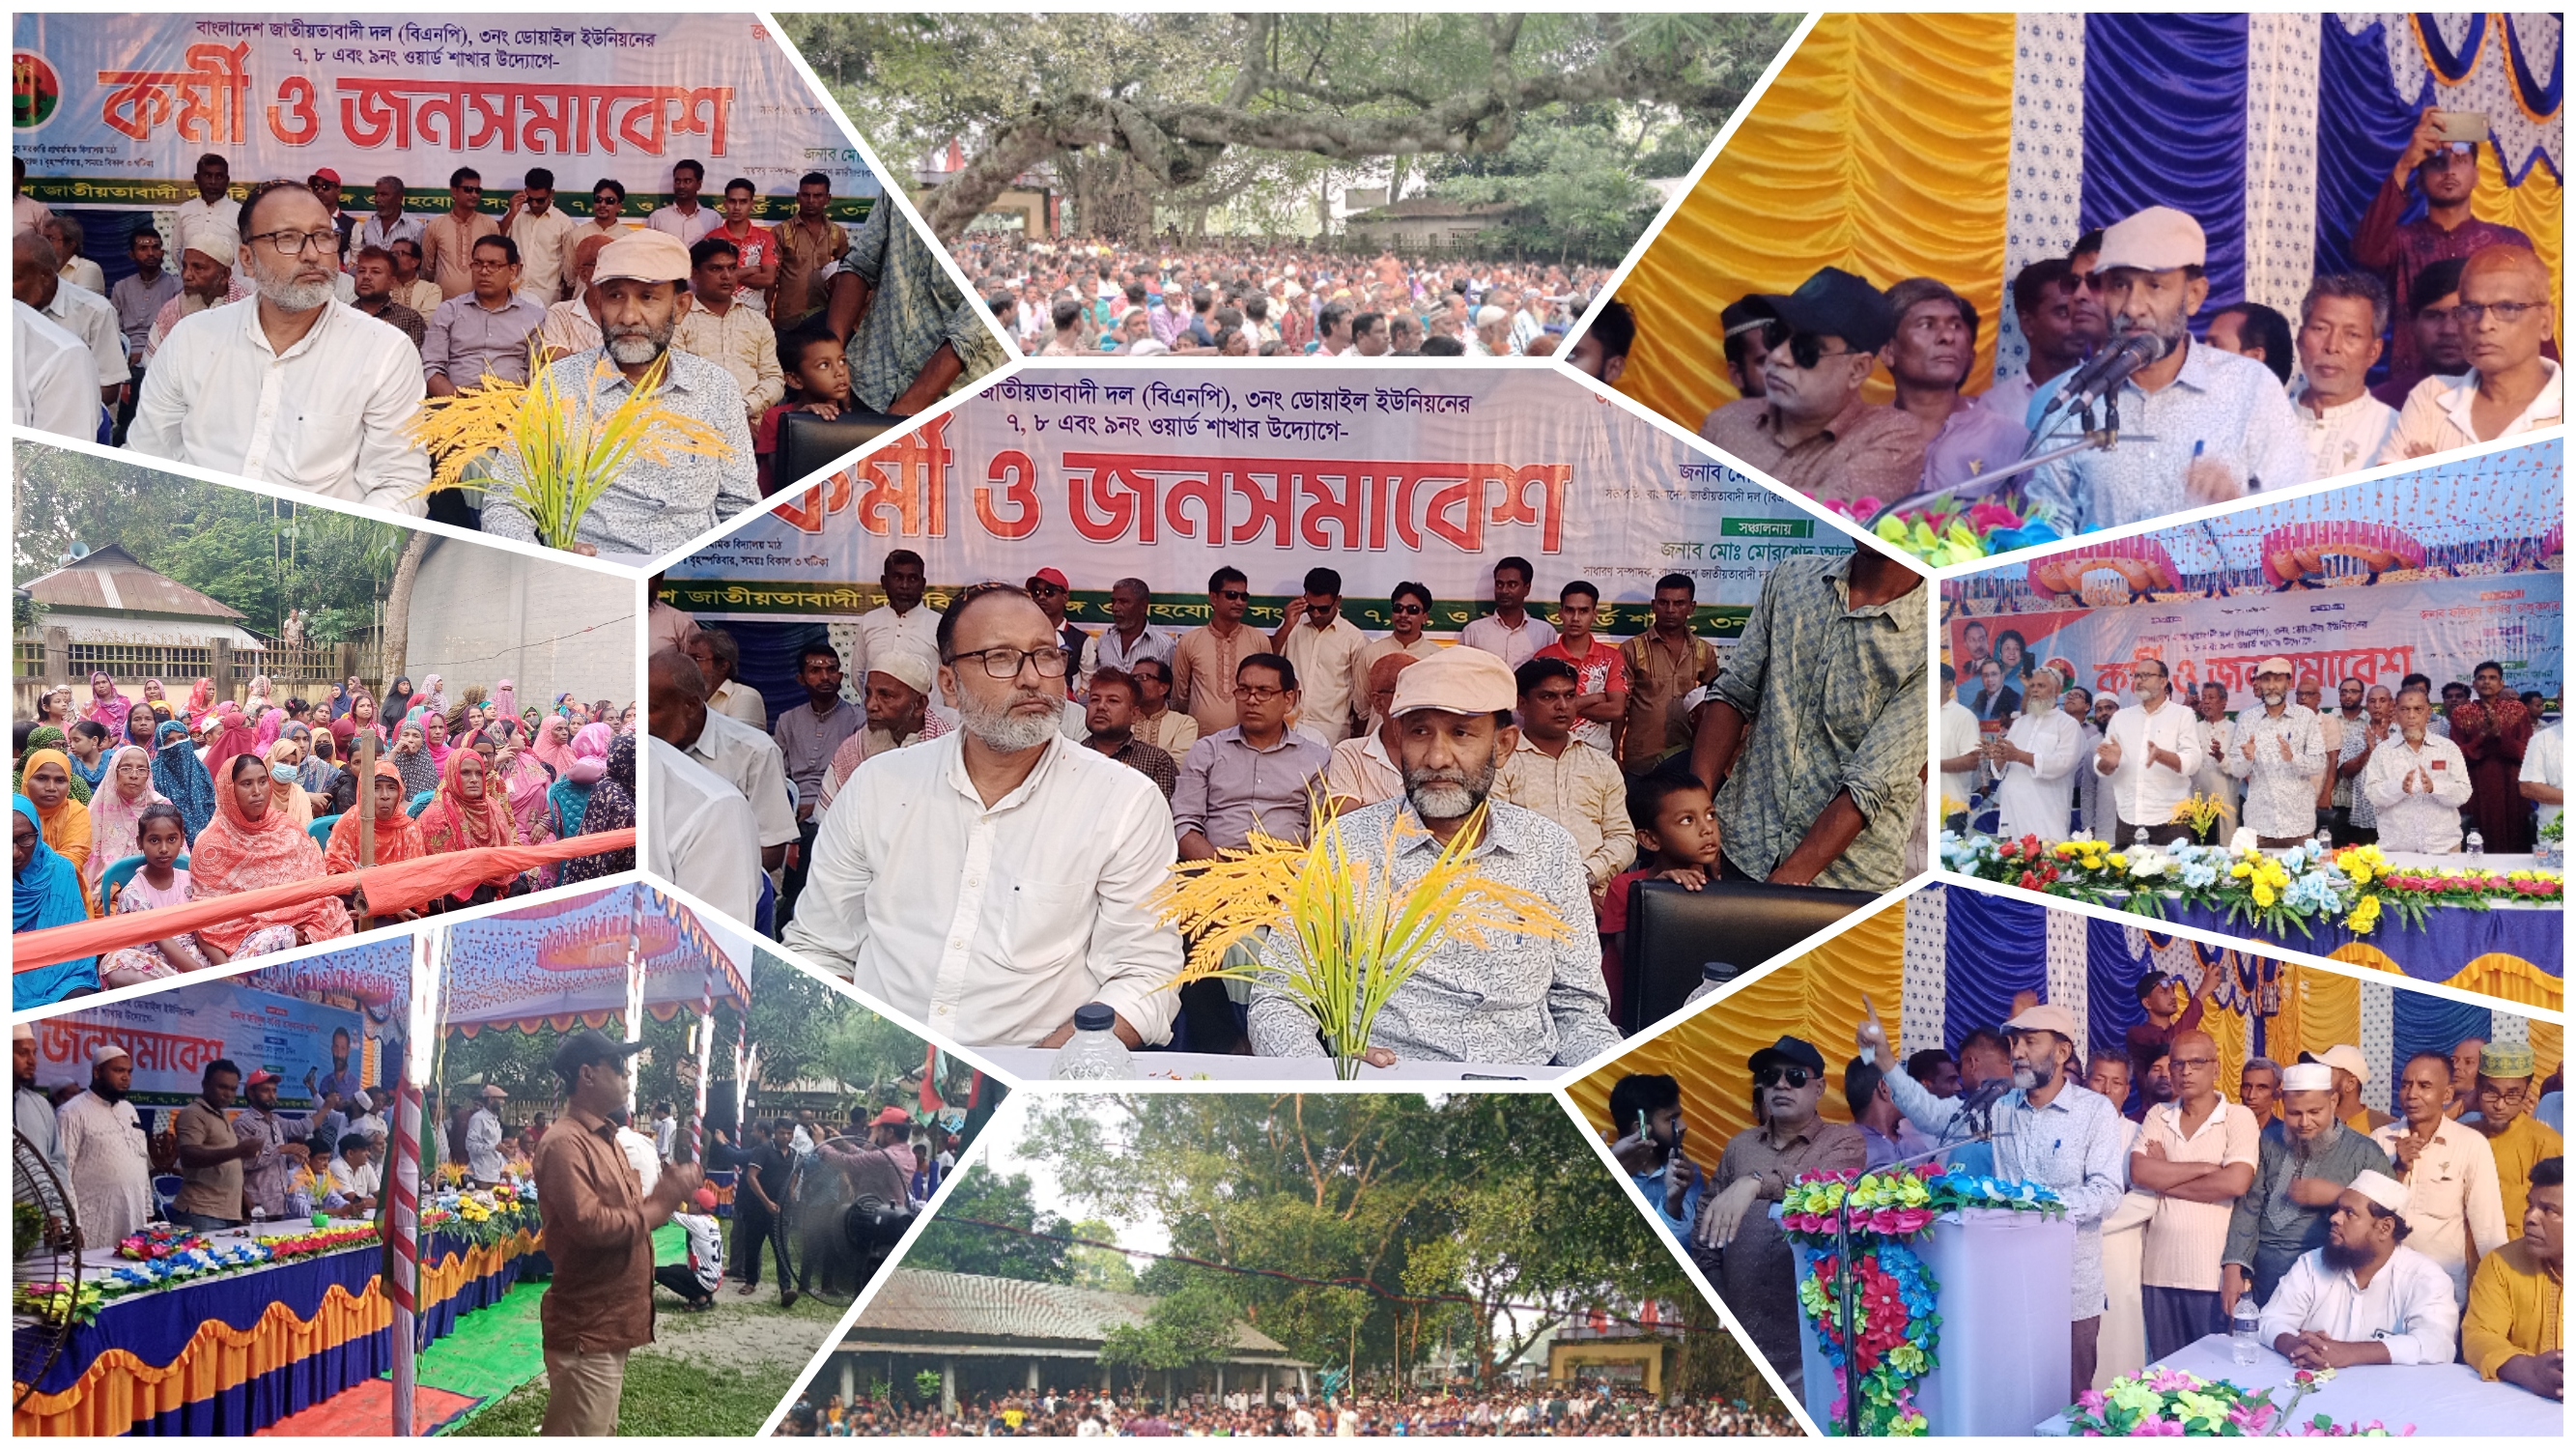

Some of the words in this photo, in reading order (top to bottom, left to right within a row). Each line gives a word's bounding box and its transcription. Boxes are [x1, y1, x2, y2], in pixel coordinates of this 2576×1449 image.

[195, 19, 265, 38] বাংলাদেশ
[269, 18, 364, 41] জাতীয়তাবাদী
[369, 25, 392, 42] দল
[479, 29, 510, 46] ৩নং
[515, 27, 577, 47] ডোয়াইল
[580, 27, 657, 49] ইউনিয়নের
[314, 48, 326, 62] ৮
[332, 48, 364, 66] এবং
[369, 49, 399, 67] ৯নং
[403, 46, 444, 67] ওয়ার্ড
[448, 50, 491, 69] শাখার
[98, 41, 252, 144] কর্মী
[266, 75, 320, 146] ও
[335, 77, 736, 158] জনসমাবেশ
[41, 182, 181, 199] জাতীয়তাবাদী
[1104, 385, 1136, 406] দল
[1143, 381, 1237, 413] (বিএনপি),
[1245, 390, 1285, 412] ৩নং
[1291, 386, 1370, 413] ডোয়াইল
[1374, 386, 1473, 414] ইউনিয়নের
[1006, 413, 1026, 437] ৭,
[1034, 414, 1050, 432] ৮
[1059, 414, 1099, 436] এবং
[1105, 415, 1143, 438] ৯নং
[1148, 412, 1201, 437] ওয়ার্ড
[1204, 418, 1261, 439] শাখার
[1679, 463, 1722, 482] জনাব
[974, 448, 1042, 541] ও
[1062, 450, 1574, 554] জনসমাবেশ
[1690, 487, 1744, 502] জাতীয়তাবাদী
[1739, 523, 1793, 536] সঞ্চালনায়
[733, 538, 765, 551] বিদ্যালয়
[767, 540, 782, 550] মাঠ
[1660, 542, 1704, 560] জনাব
[1709, 543, 1741, 561] মোঃ
[767, 554, 792, 567] বিকাল
[804, 555, 829, 568] ঘটিকা
[1583, 566, 1613, 577] সাধারণ
[1701, 565, 1756, 580] জাতীয়তাবাদী
[684, 585, 863, 609] জাতীয়তাবাদী
[1448, 611, 1468, 622] ও
